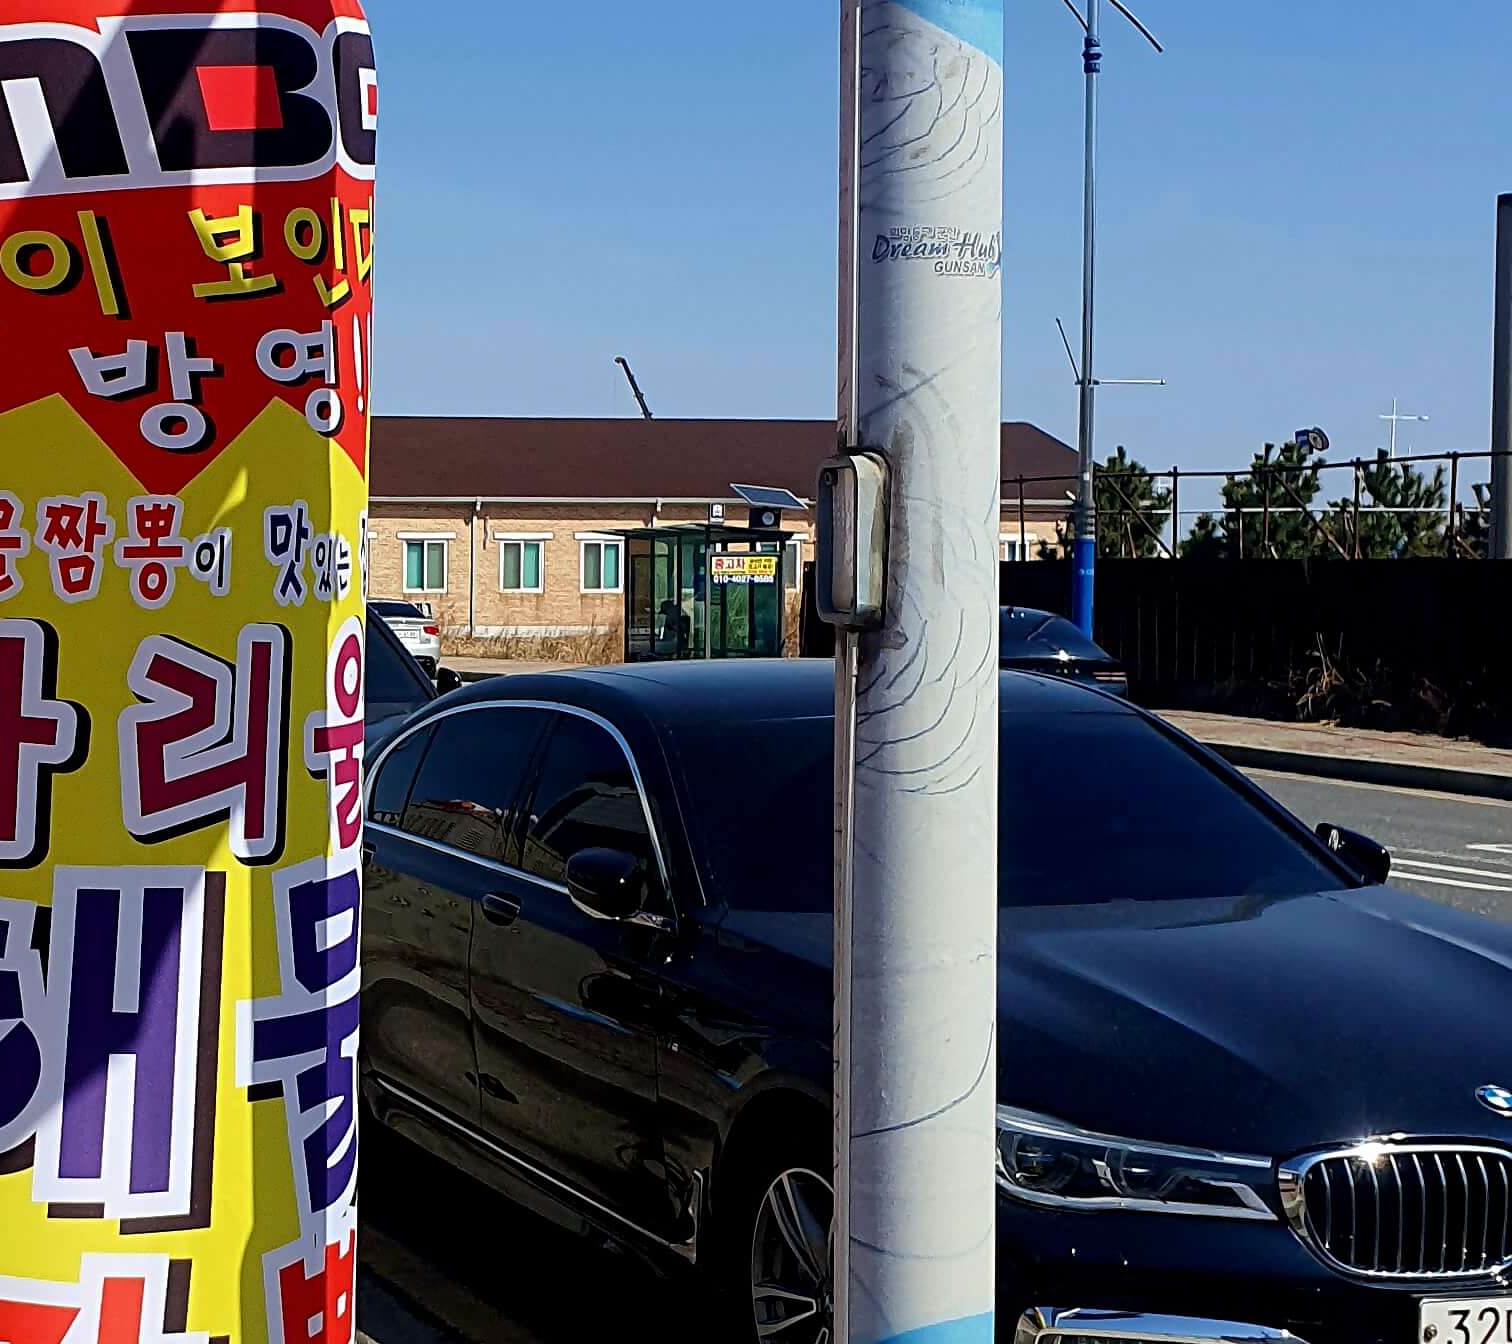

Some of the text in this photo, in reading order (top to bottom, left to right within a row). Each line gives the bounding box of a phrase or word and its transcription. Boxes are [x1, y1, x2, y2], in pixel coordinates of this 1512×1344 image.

[872, 234, 948, 262] Dream
[934, 261, 985, 275] GUNSAN
[269, 501, 351, 600] 맛있는
